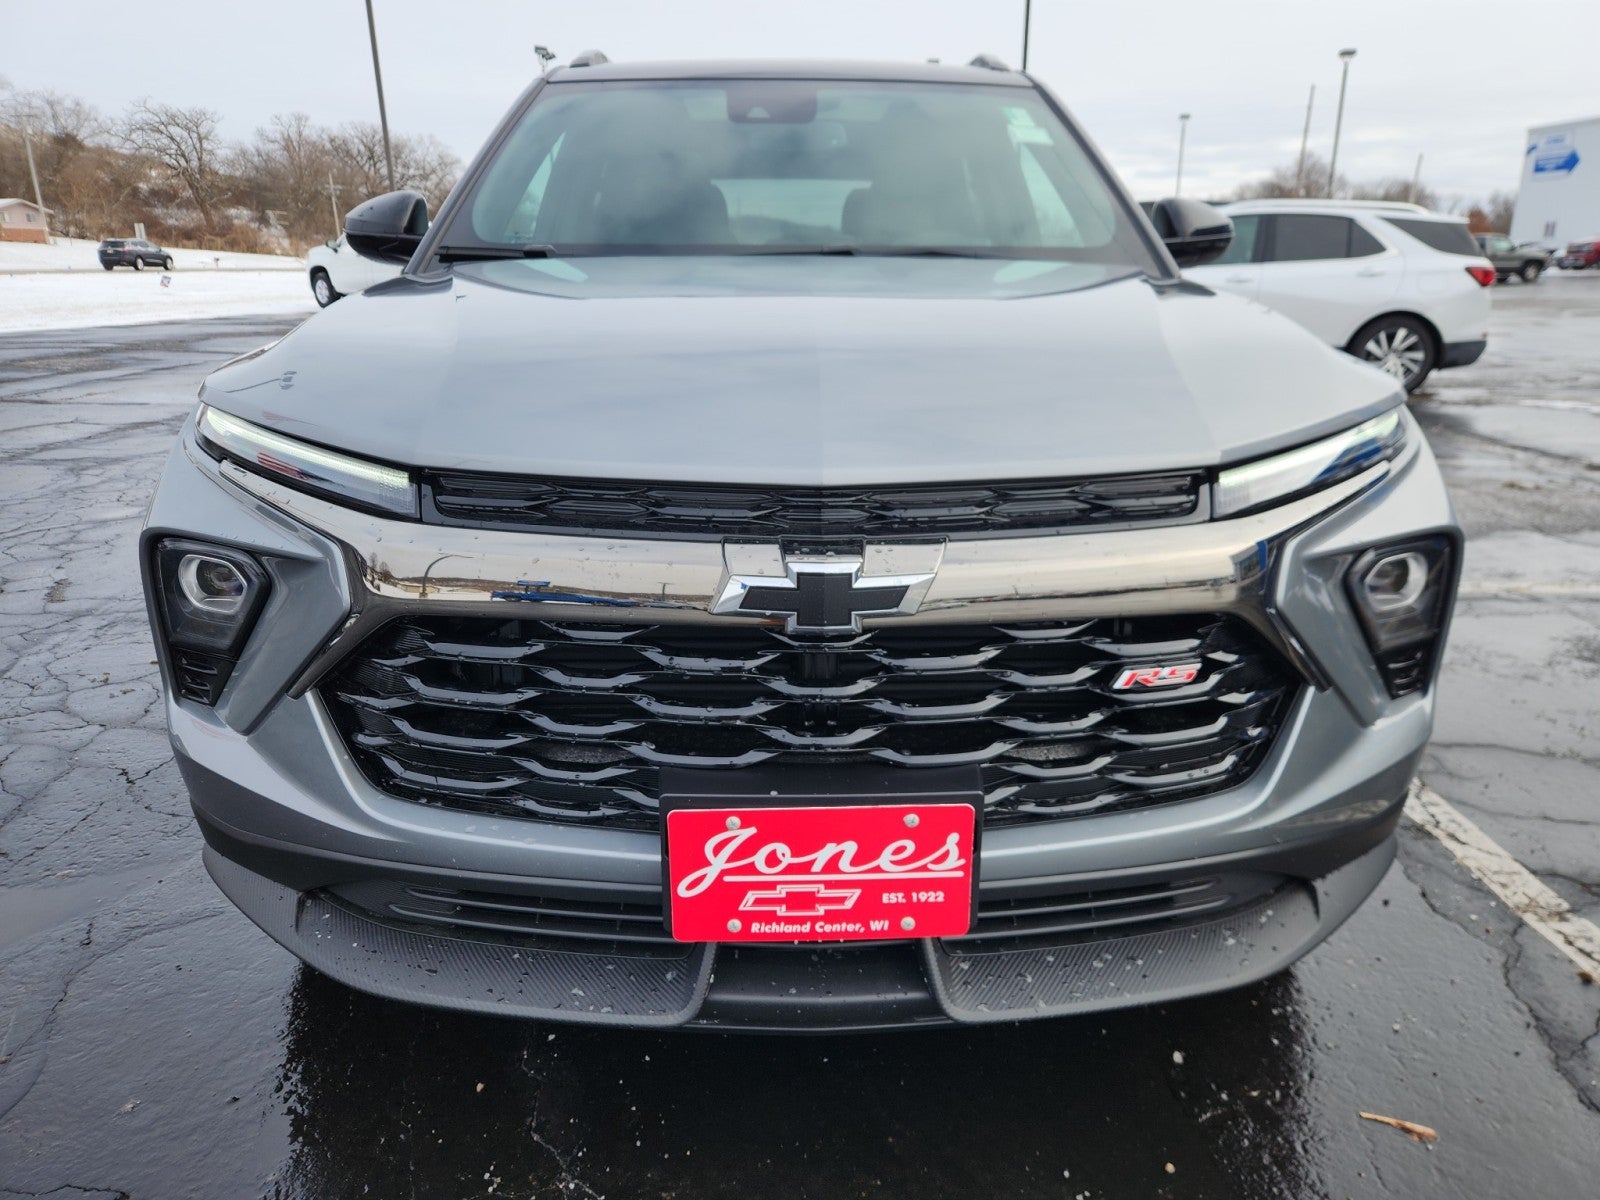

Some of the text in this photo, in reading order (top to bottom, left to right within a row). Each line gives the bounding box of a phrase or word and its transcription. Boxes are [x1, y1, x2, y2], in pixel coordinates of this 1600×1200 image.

[1112, 663, 1202, 689] RS
[676, 826, 966, 898] Jones
[882, 890, 945, 904] EST. 1922
[750, 919, 890, 934] Richland Center, WI
